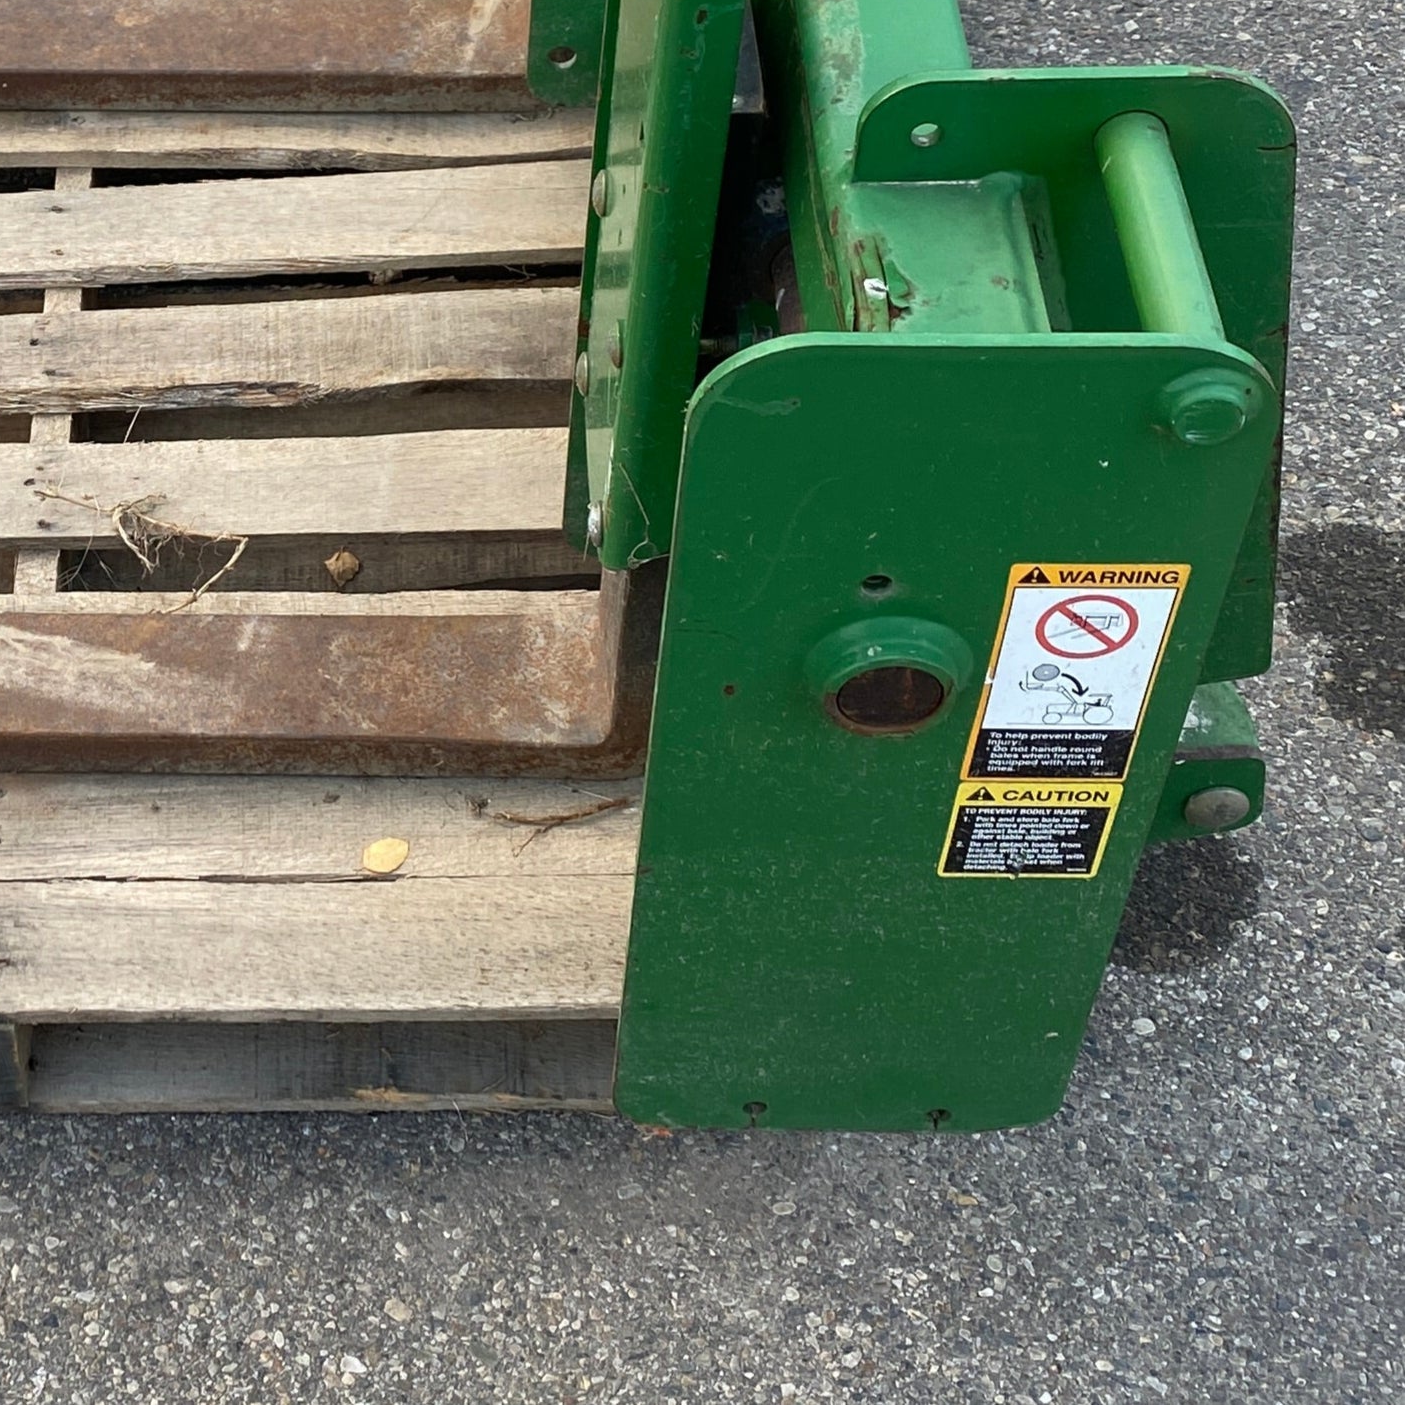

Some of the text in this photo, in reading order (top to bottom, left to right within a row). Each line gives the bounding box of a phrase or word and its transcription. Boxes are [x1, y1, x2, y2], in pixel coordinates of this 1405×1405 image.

[1058, 570, 1180, 585] WARNING
[1005, 732, 1029, 741] help
[1030, 733, 1072, 741] prevent
[1074, 733, 1108, 741] bodily
[1031, 746, 1067, 754] handle
[1069, 746, 1103, 754] round
[990, 752, 1019, 760] bales
[988, 759, 1039, 767] equipped
[1066, 759, 1088, 767] fork
[1002, 790, 1110, 802] CAUTION
